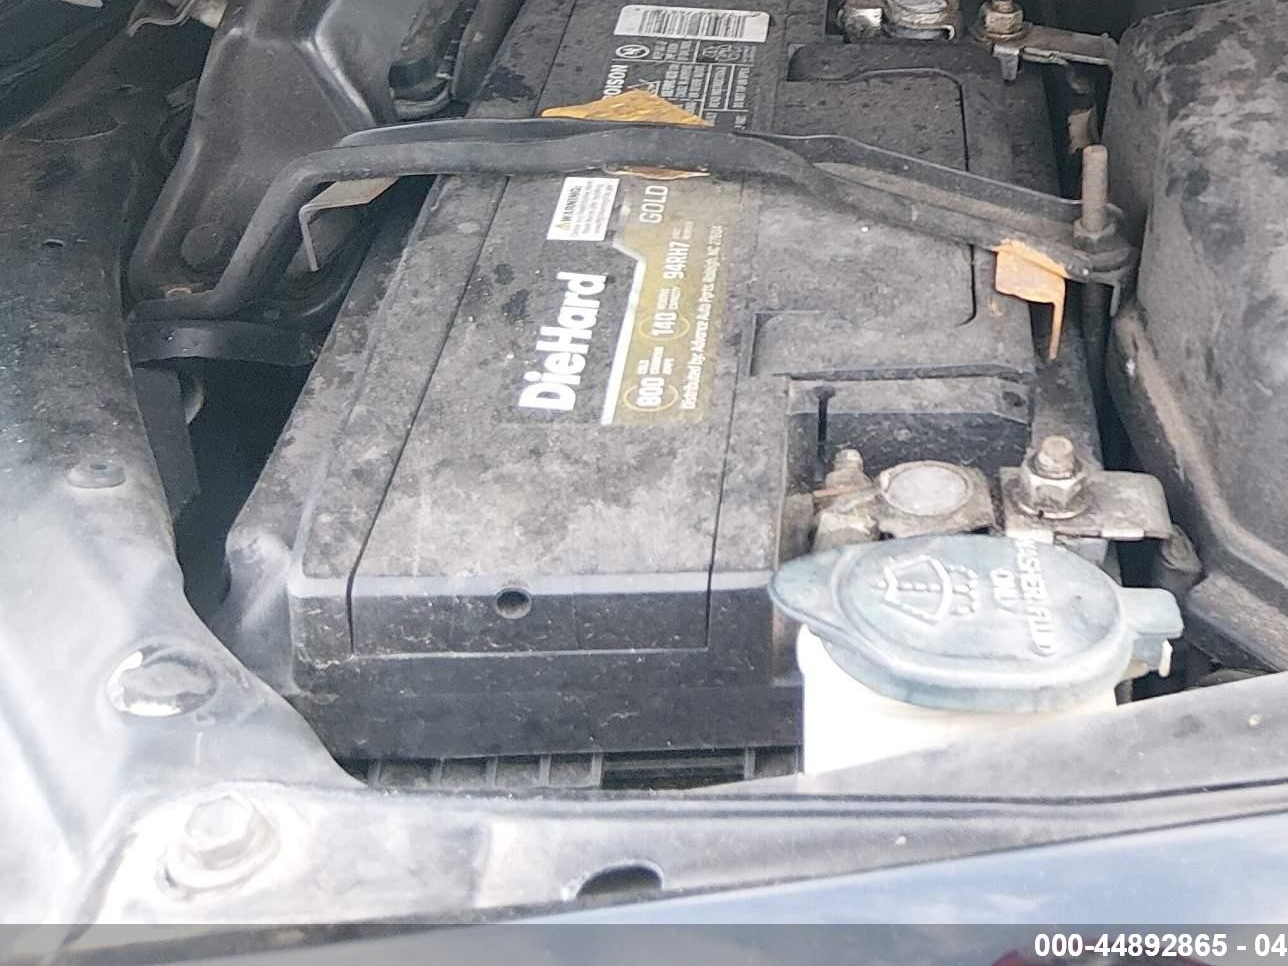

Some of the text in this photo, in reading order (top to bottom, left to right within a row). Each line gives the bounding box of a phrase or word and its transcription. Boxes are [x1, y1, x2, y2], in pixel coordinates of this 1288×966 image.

[602, 64, 629, 98] OISON
[640, 185, 669, 224] GOLD
[663, 241, 690, 279] 94RH7
[652, 312, 677, 335] 140
[696, 303, 711, 321] Auto
[518, 272, 608, 411] DieHard
[691, 321, 710, 352] Advance
[636, 377, 665, 407] 800
[680, 365, 702, 409] Distributed
